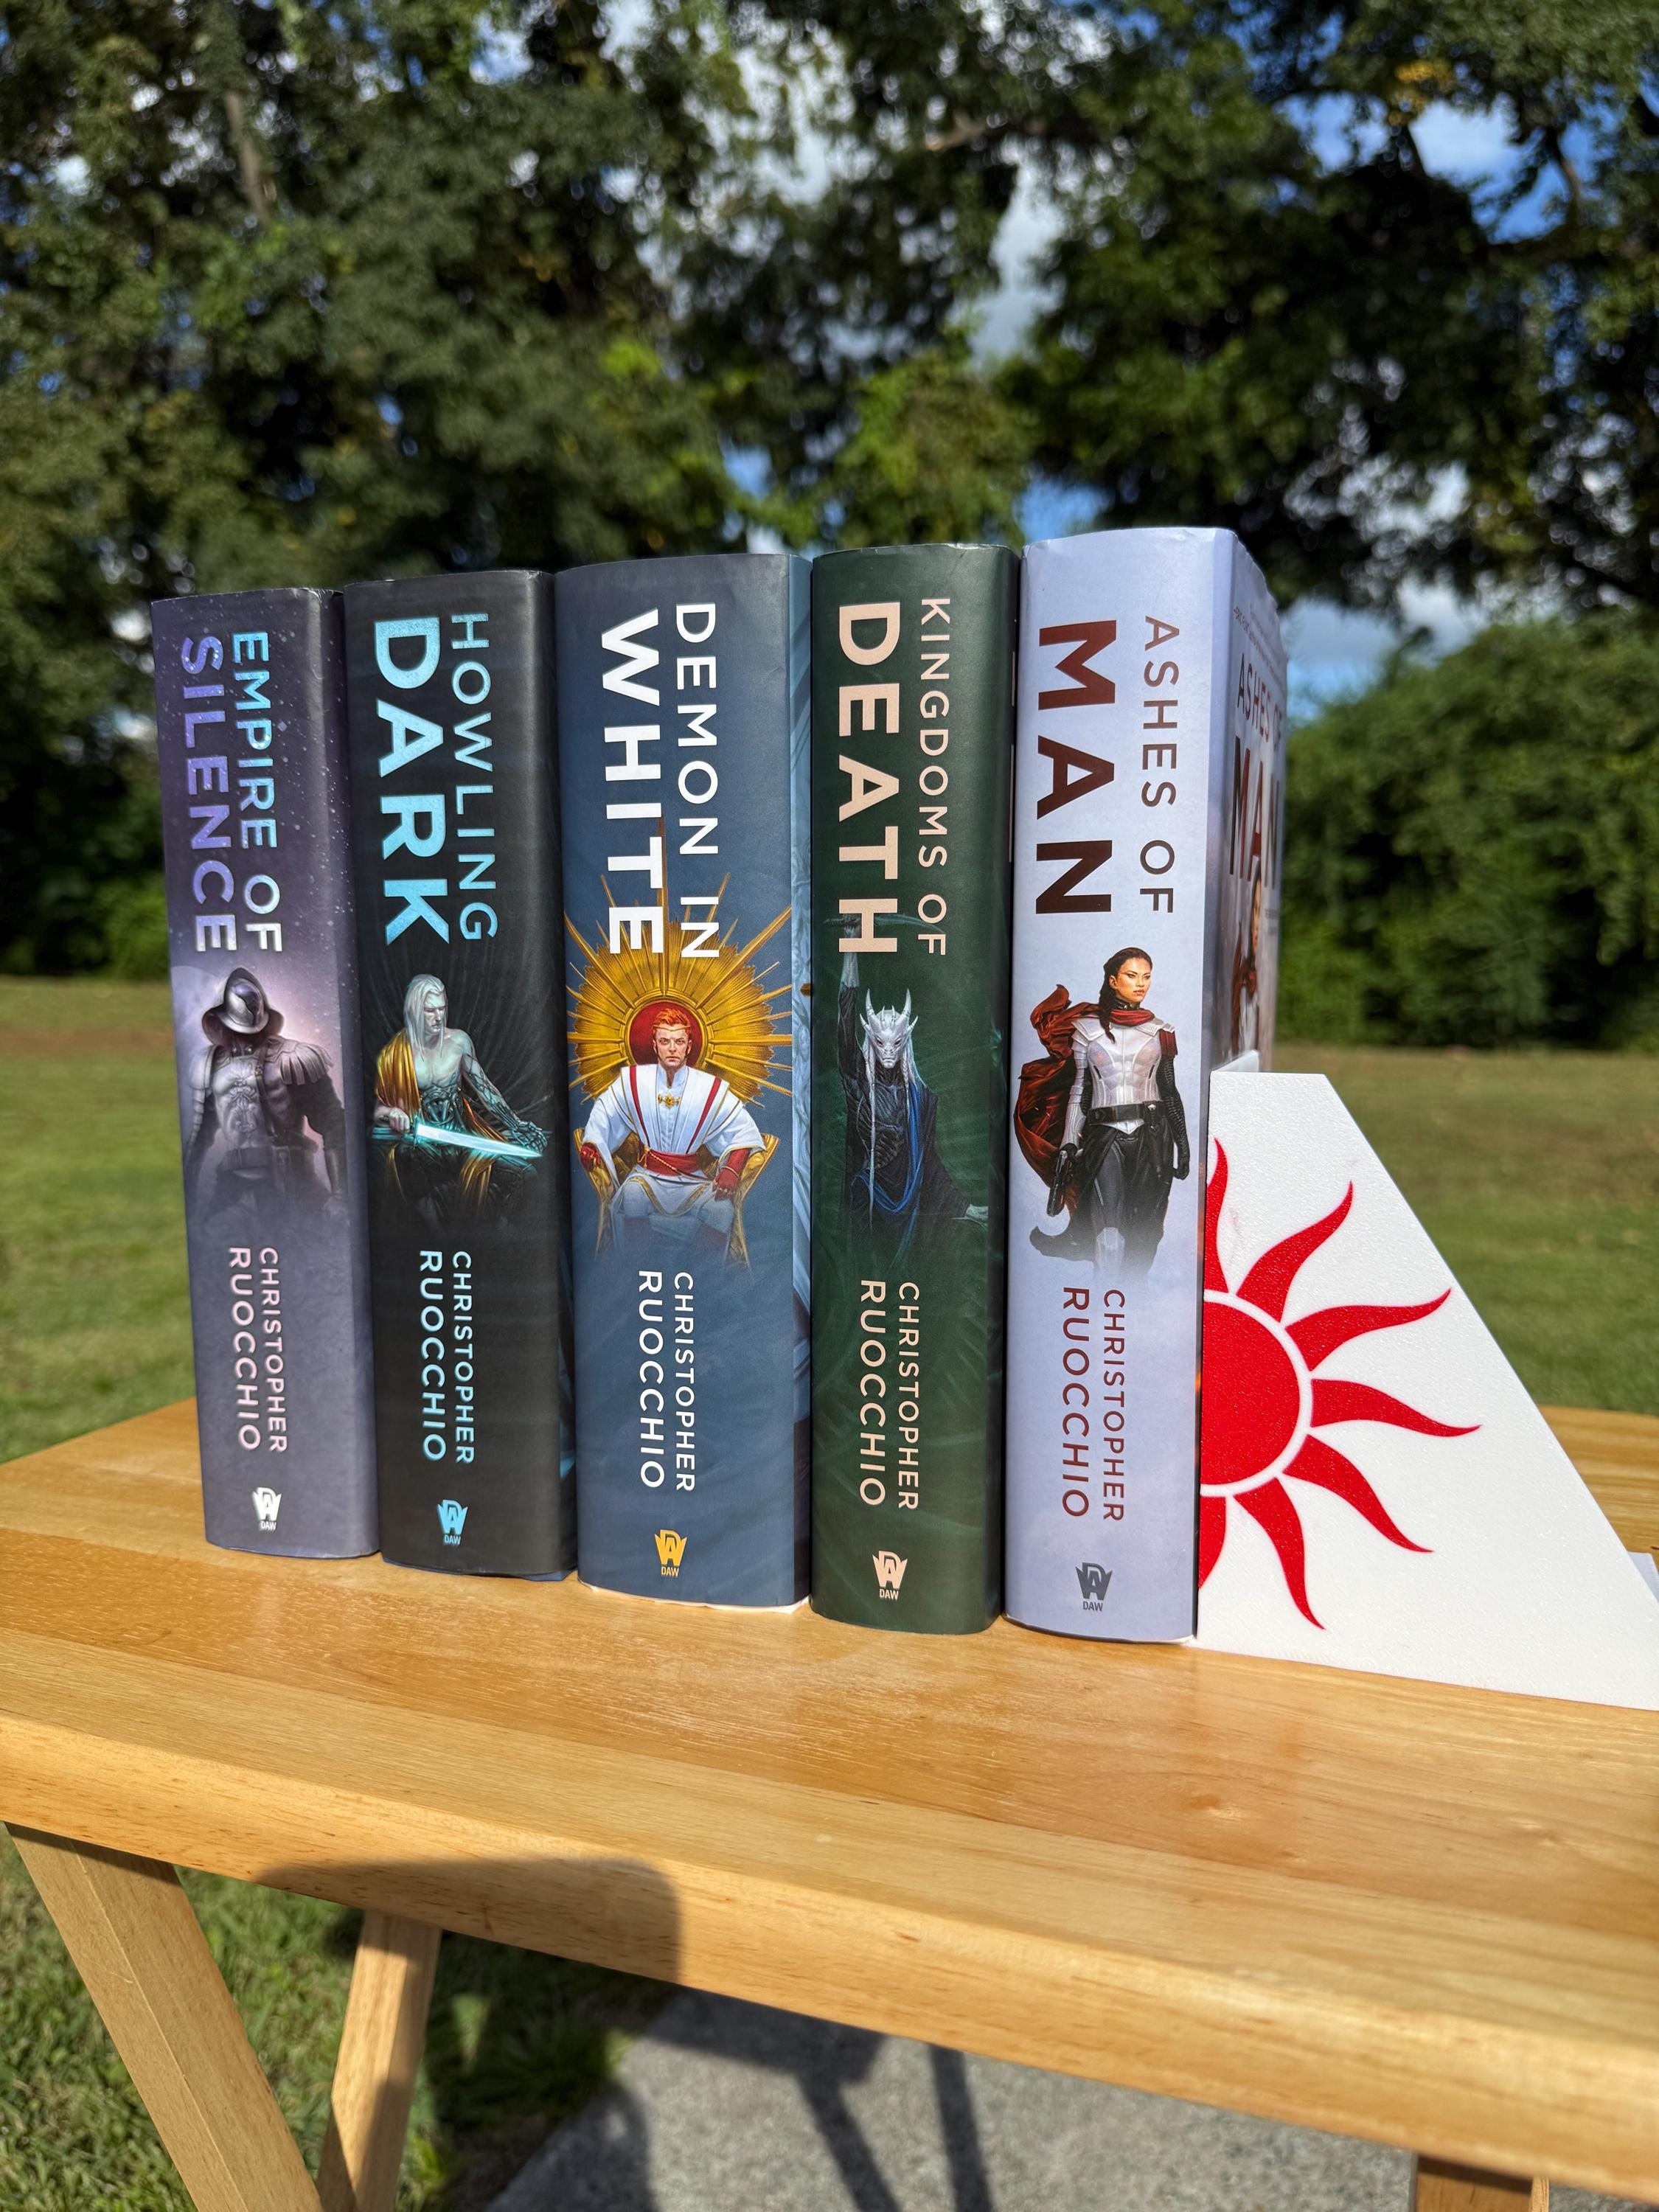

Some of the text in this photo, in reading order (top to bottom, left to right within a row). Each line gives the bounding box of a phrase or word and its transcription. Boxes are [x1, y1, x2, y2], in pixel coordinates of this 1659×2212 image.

[181, 636, 237, 952] SILENCE
[232, 631, 282, 952] EMPIRE OF
[374, 616, 450, 945] DARK
[451, 613, 498, 940] HOWLING
[601, 607, 664, 954] WHITE
[675, 602, 720, 958] DEMON IN
[838, 602, 900, 954] DEATH
[917, 598, 951, 956] KINGDOMS OF
[1035, 619, 1117, 914] MAN
[1139, 616, 1180, 914] ASHES OF
[1237, 653, 1270, 743] ASHES
[1231, 735, 1281, 890] MAN
[229, 1247, 261, 1450] RUOCCHIO
[259, 1247, 288, 1453] CHRISTOPHER
[420, 1250, 446, 1461] RUOCCHIO
[452, 1251, 474, 1464] CHRISTOPHER
[639, 1270, 665, 1488] RUOCCHIO
[674, 1272, 695, 1492] CHRISTOPHER
[860, 1279, 886, 1506] RUOCCHIO
[898, 1282, 919, 1509] CHRISTOPHER
[1062, 1287, 1090, 1517] RUOCCHIO
[1103, 1290, 1125, 1521] CHRISTOPHER
[260, 1521, 277, 1531] DAW
[444, 1534, 461, 1546] DAW
[661, 1566, 680, 1577] DAW
[880, 1588, 899, 1600] DAW
[1082, 1601, 1103, 1612] DAW
